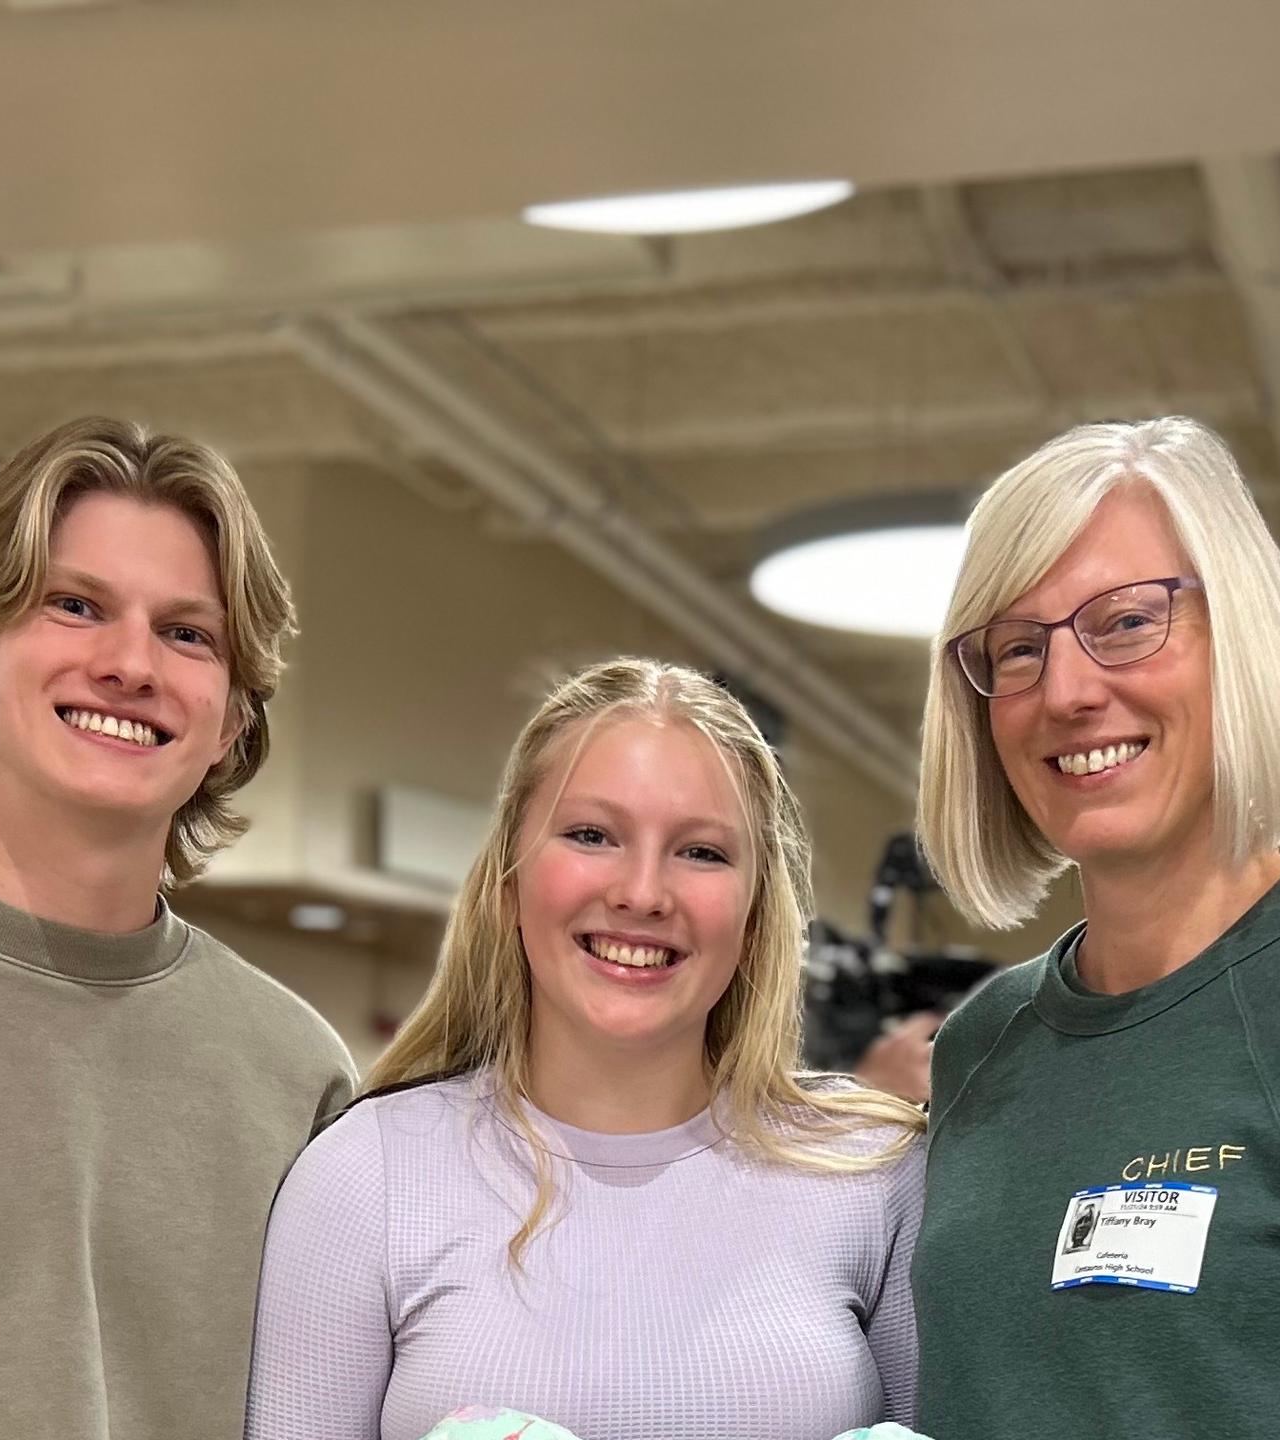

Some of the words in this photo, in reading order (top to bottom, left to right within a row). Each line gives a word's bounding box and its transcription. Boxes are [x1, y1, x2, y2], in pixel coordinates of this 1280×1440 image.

[1122, 1145, 1246, 1181] CHIEF
[1124, 1191, 1180, 1204] VISITOR
[1101, 1215, 1131, 1228] Tiffany
[1133, 1216, 1157, 1229] Bray
[1105, 1264, 1123, 1273] High
[1125, 1265, 1154, 1275] School
